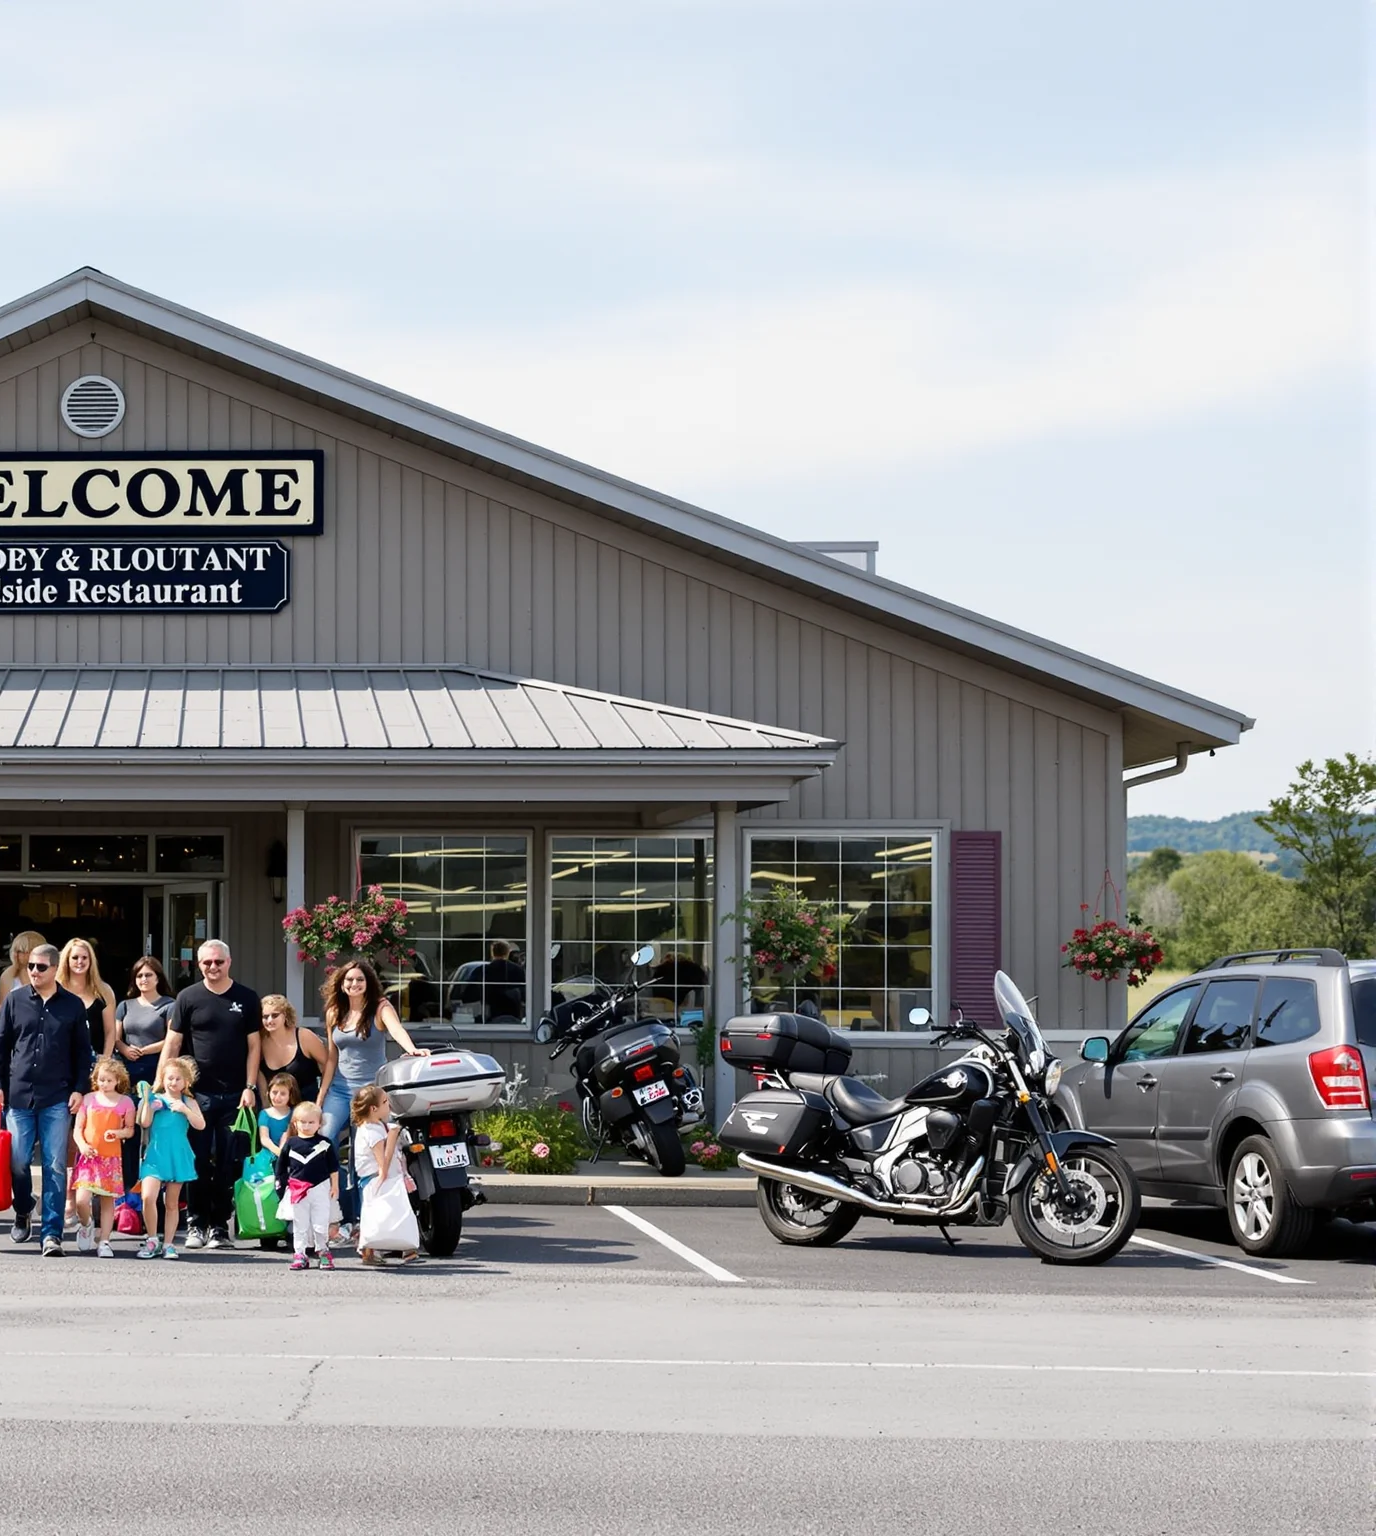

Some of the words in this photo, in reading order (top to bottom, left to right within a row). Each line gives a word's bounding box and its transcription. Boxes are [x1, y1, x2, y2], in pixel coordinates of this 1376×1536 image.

[55, 547, 80, 572] &
[89, 547, 271, 572] RLOUTANT
[67, 578, 243, 604] Restaurant
